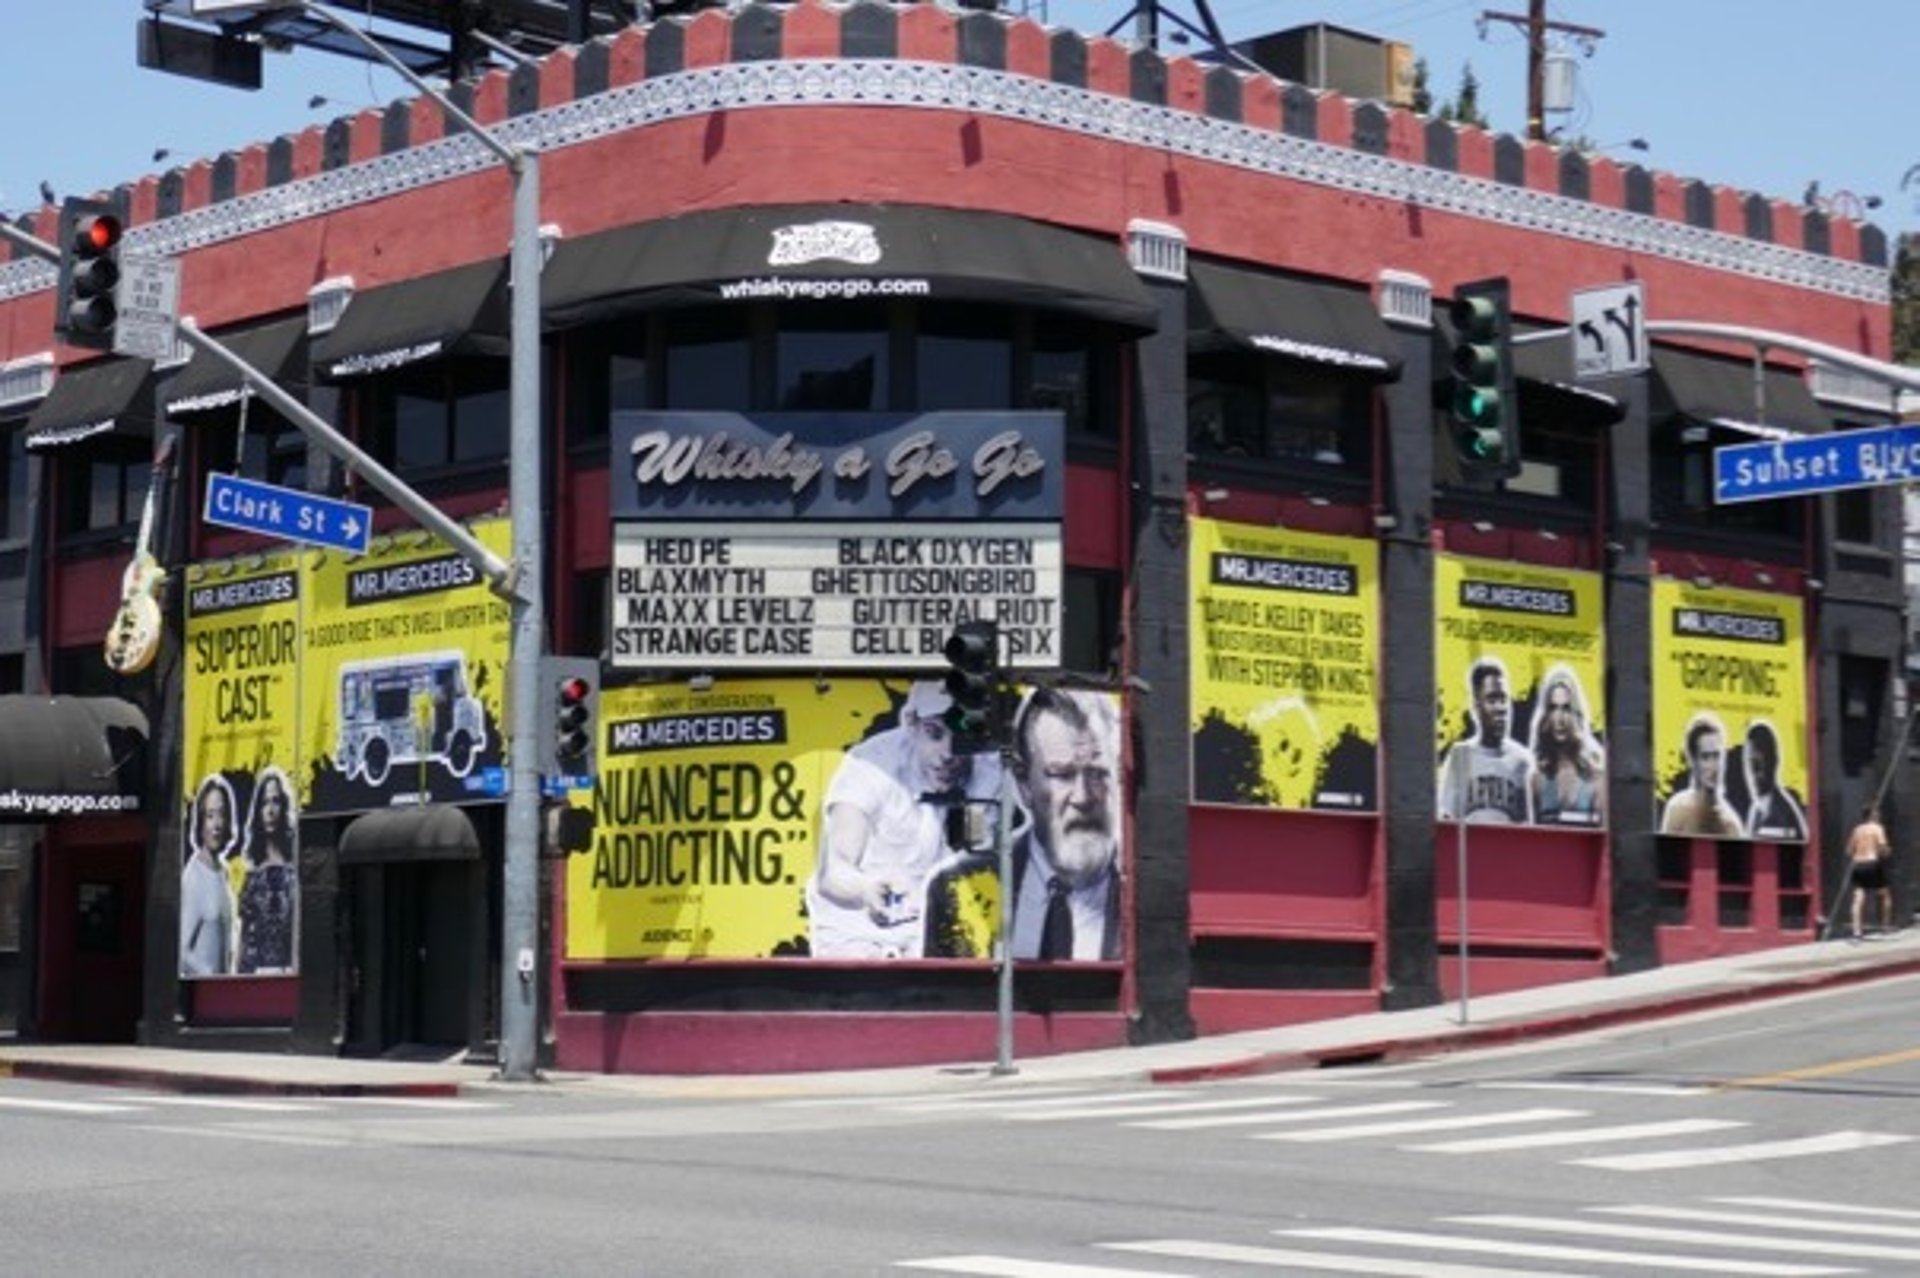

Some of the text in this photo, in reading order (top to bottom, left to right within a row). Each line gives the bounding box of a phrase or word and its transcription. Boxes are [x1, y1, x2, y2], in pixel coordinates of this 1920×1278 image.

[720, 277, 930, 298] whiskyagogo.com
[631, 431, 1045, 496] Whisky a Go Go
[1736, 448, 1839, 486] Sunset
[217, 488, 325, 534] Clark St
[701, 538, 731, 564] PE
[839, 539, 1033, 565] BLACK OXYGEN
[618, 568, 766, 594] BLAXMYTH
[812, 568, 1036, 594] GHETTOSONGBIRD
[628, 599, 814, 624] MAXX LEVELZ
[853, 599, 1054, 625] GUTTERAL RIOT
[615, 628, 813, 654] STRANGE CASE
[852, 628, 912, 654] CELL
[594, 761, 806, 826] NUANCED &
